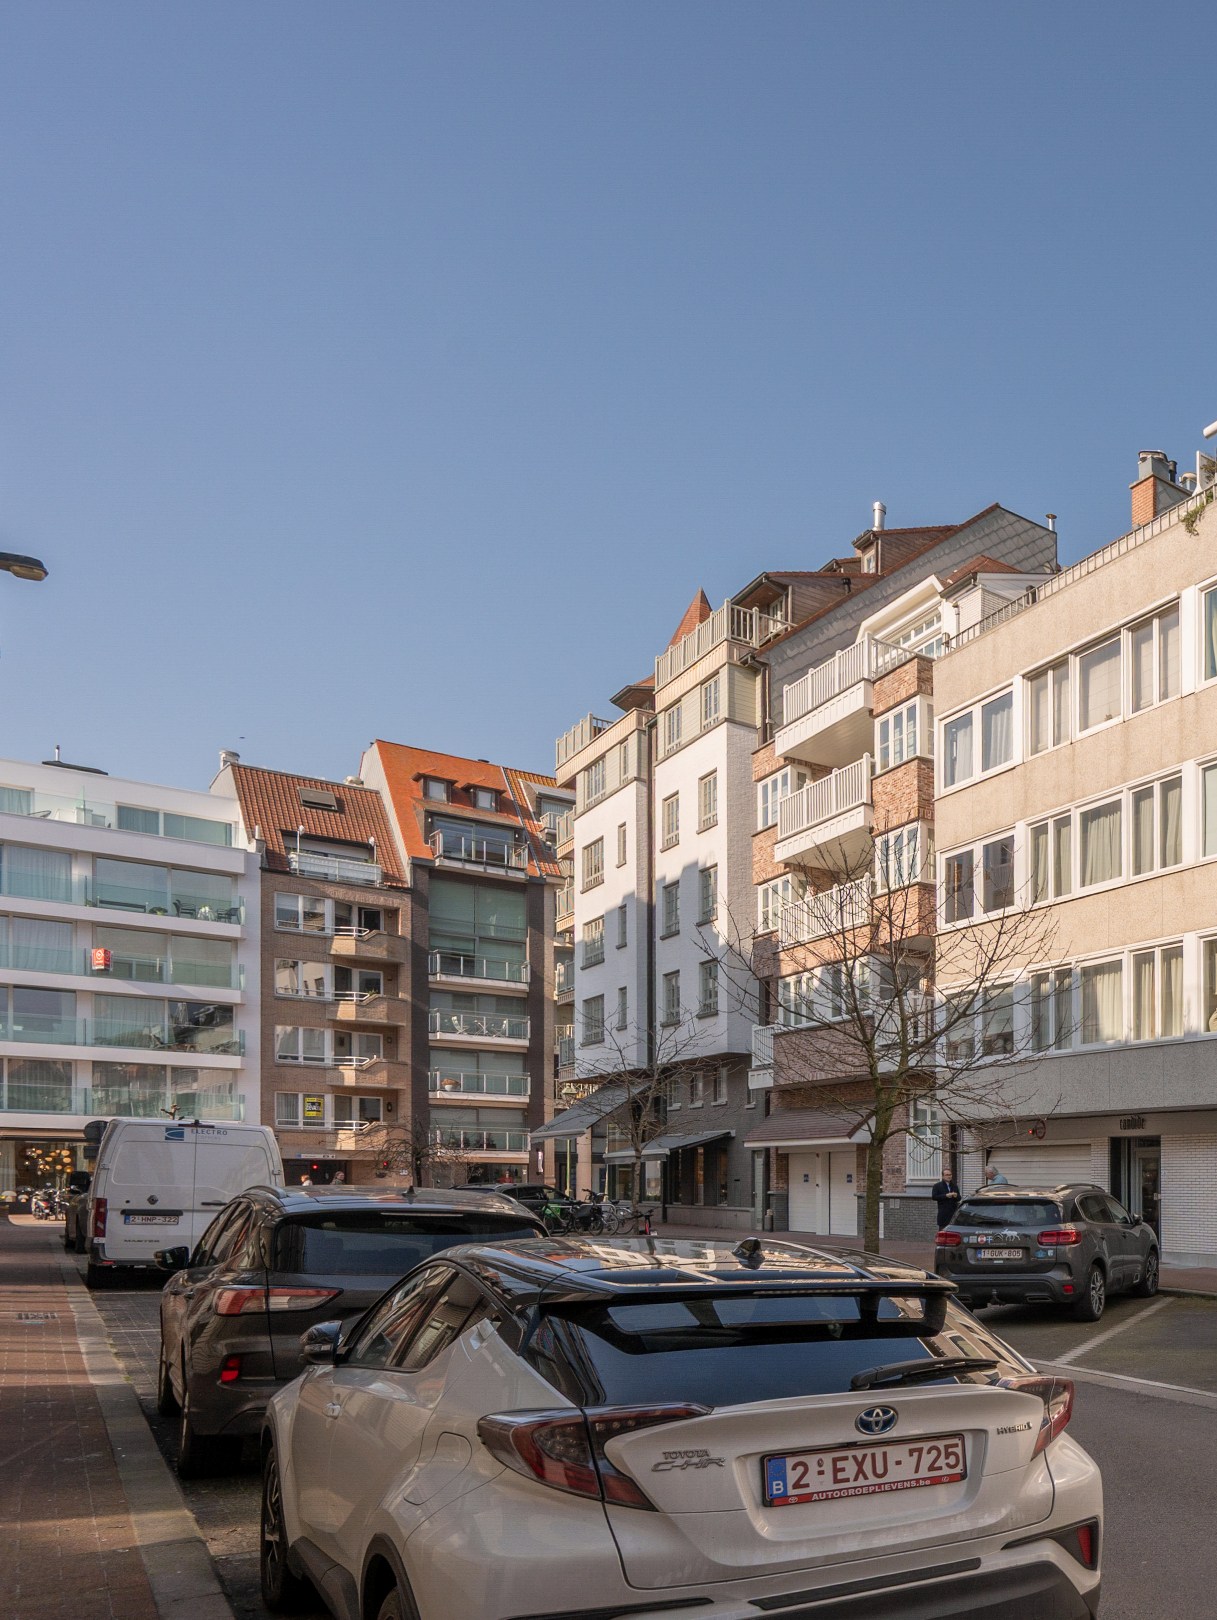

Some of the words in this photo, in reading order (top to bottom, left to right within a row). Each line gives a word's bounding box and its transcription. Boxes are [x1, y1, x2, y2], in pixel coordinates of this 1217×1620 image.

[191, 1128, 228, 1136] ELECTRO
[662, 1449, 710, 1460] TOYOTA
[790, 1443, 961, 1490] 2-EXU-725
[772, 1480, 785, 1495] B
[811, 1479, 931, 1501] AUTOGROEPLIEVENS.be
